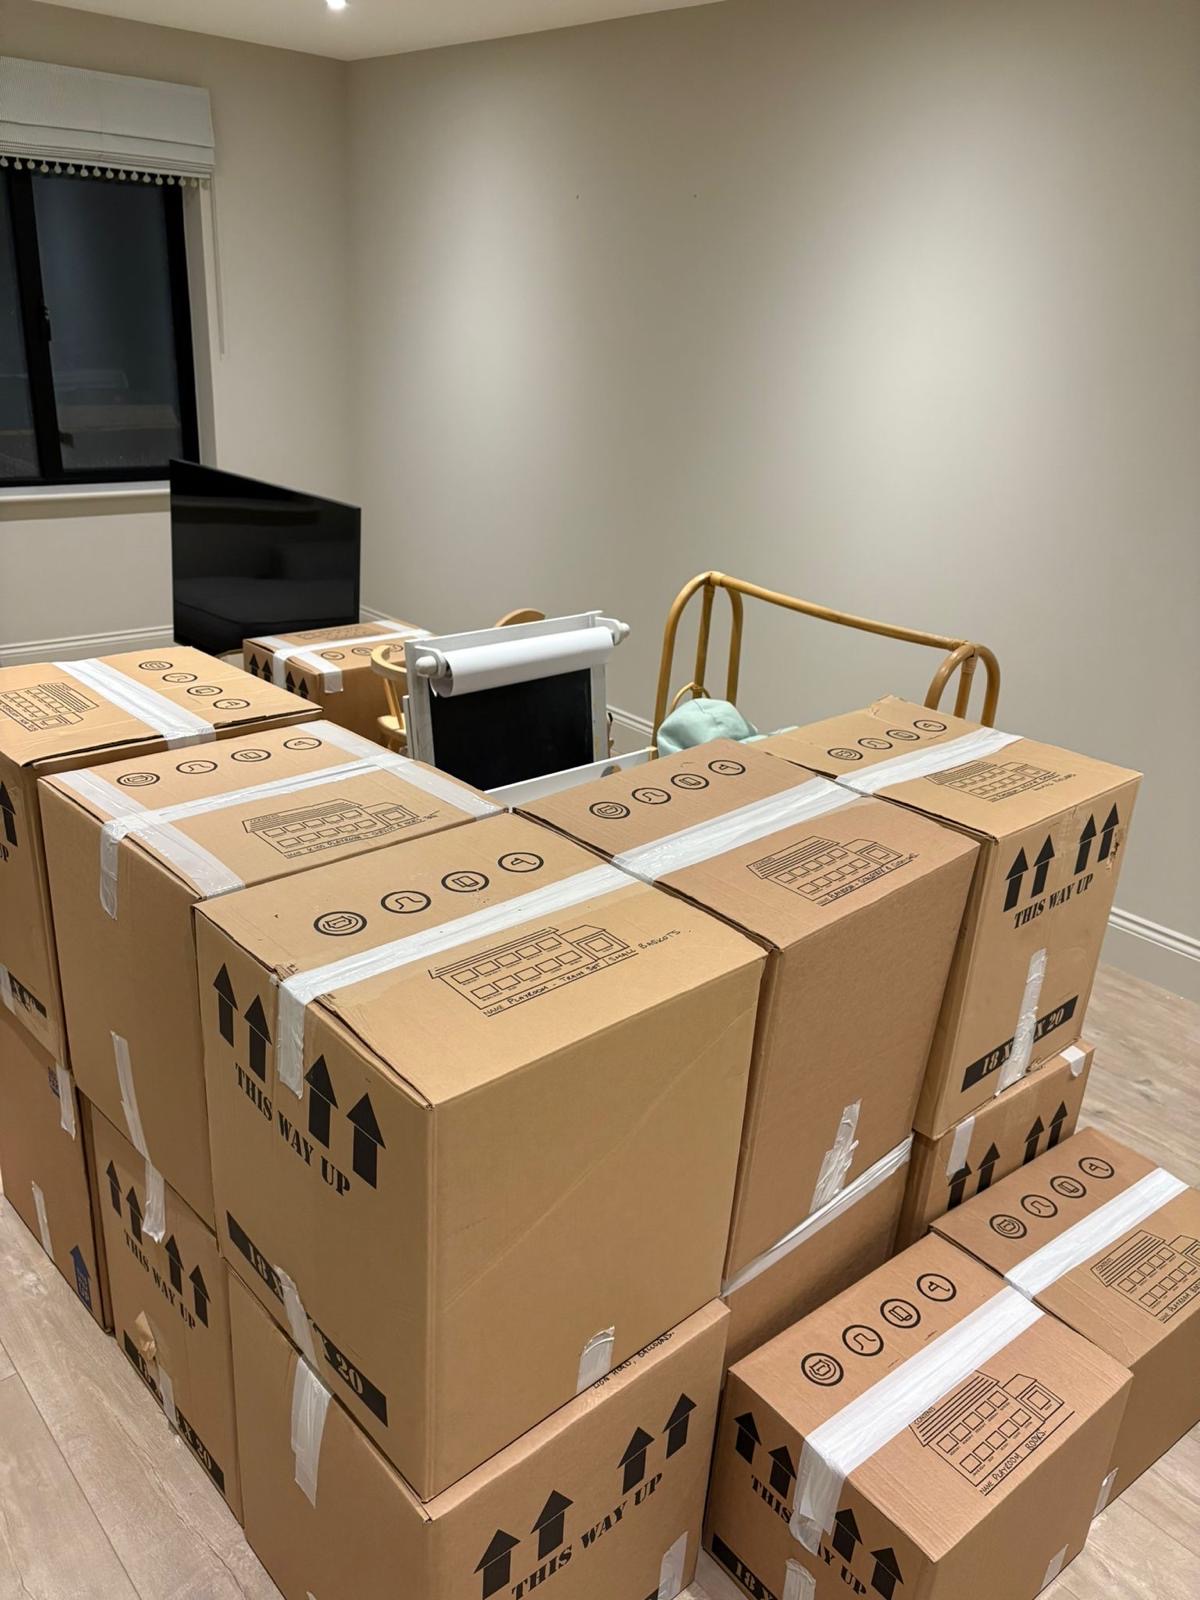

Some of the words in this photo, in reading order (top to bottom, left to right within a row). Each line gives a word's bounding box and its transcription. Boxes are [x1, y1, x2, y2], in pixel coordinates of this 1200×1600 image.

[1014, 899, 1046, 929] THIS
[1049, 883, 1075, 910] WAY
[1076, 873, 1093, 895] UP
[982, 1051, 1000, 1076] 18
[1047, 1008, 1065, 1031] 20
[235, 1061, 273, 1121] THIS
[278, 1110, 314, 1167] WAY
[321, 1155, 351, 1197] UP
[124, 1229, 150, 1273] THIS
[152, 1266, 175, 1307] WAY
[179, 1302, 196, 1330] UP
[248, 1242, 269, 1280] 18
[336, 1353, 364, 1394] 20
[914, 1406, 936, 1425] CONTENTS
[979, 1480, 994, 1495] NAME
[511, 1544, 573, 1600] THIS
[580, 1500, 628, 1549] WAY
[634, 1473, 663, 1506] UP
[735, 1560, 756, 1592] 18
[751, 1474, 793, 1524] THIS
[840, 1565, 867, 1595] UP
